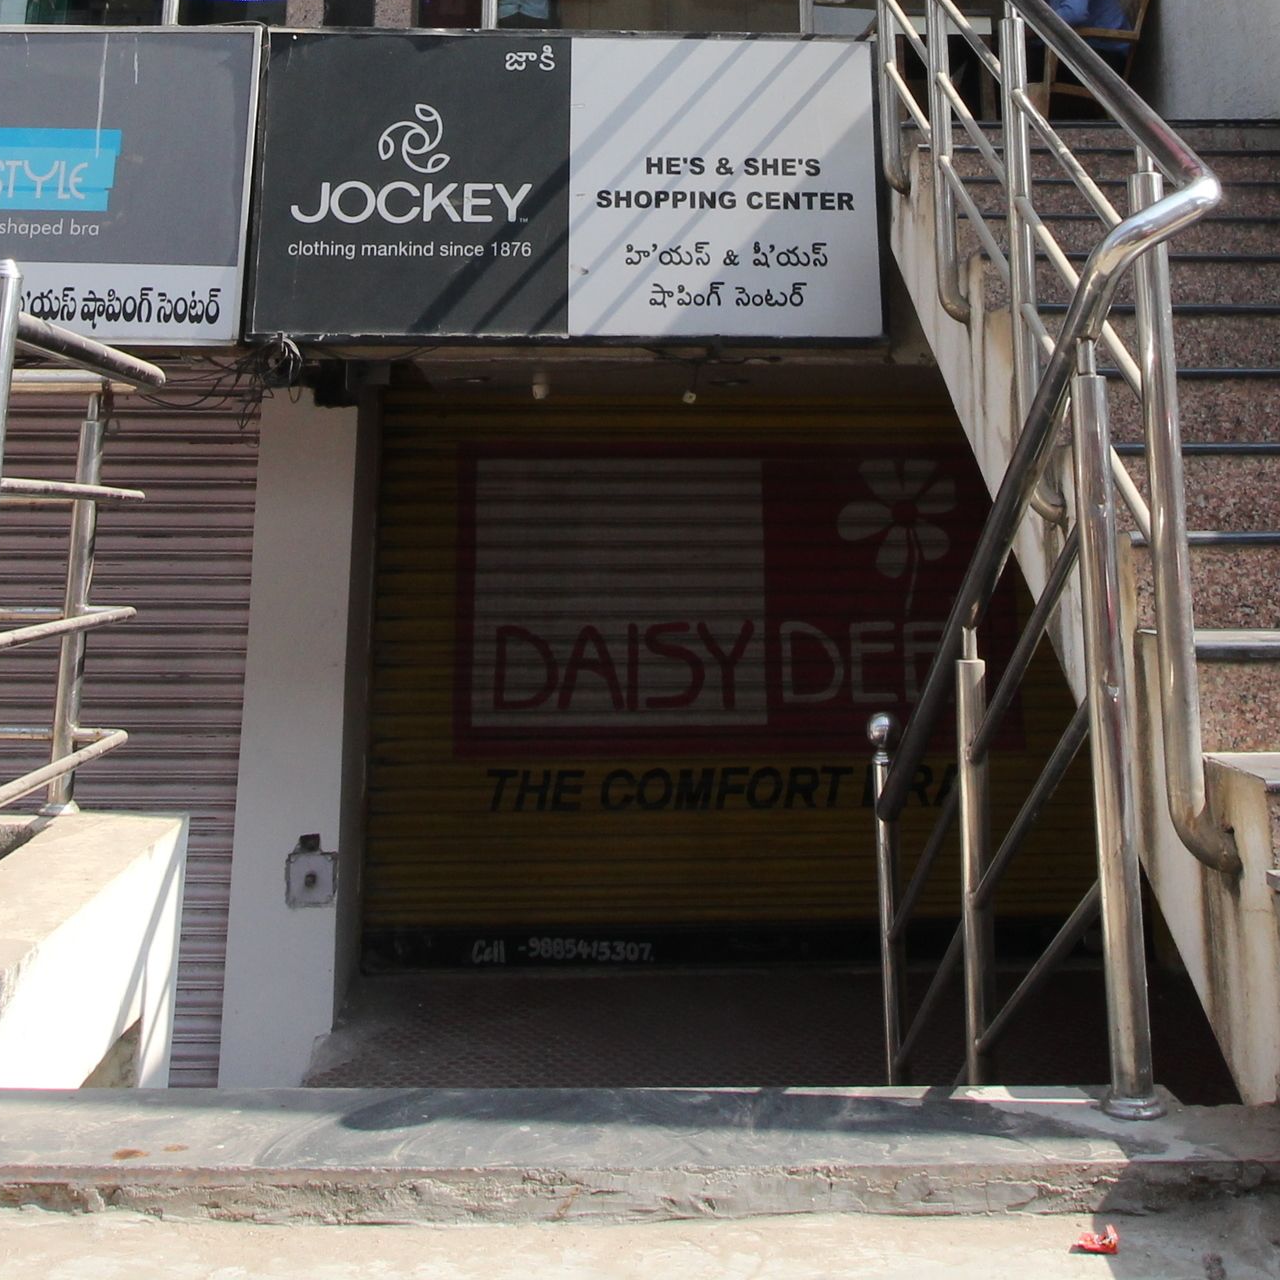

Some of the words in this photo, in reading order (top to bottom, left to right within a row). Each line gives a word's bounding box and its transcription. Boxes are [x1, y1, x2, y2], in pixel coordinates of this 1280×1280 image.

[645, 156, 706, 176] HE'S
[715, 156, 735, 177] &
[743, 157, 822, 178] SHE'S
[290, 180, 533, 224] JOCKEY
[596, 189, 737, 210] SHOPPING
[746, 190, 856, 212] CENTER
[69, 218, 100, 236] bra
[287, 240, 356, 260] clothing
[360, 241, 434, 258] mankind
[439, 241, 485, 258] since
[490, 241, 532, 258] 1876
[722, 249, 740, 267] &
[492, 619, 756, 712] DAISY
[487, 767, 585, 813] THE
[600, 765, 852, 812] COMFORT
